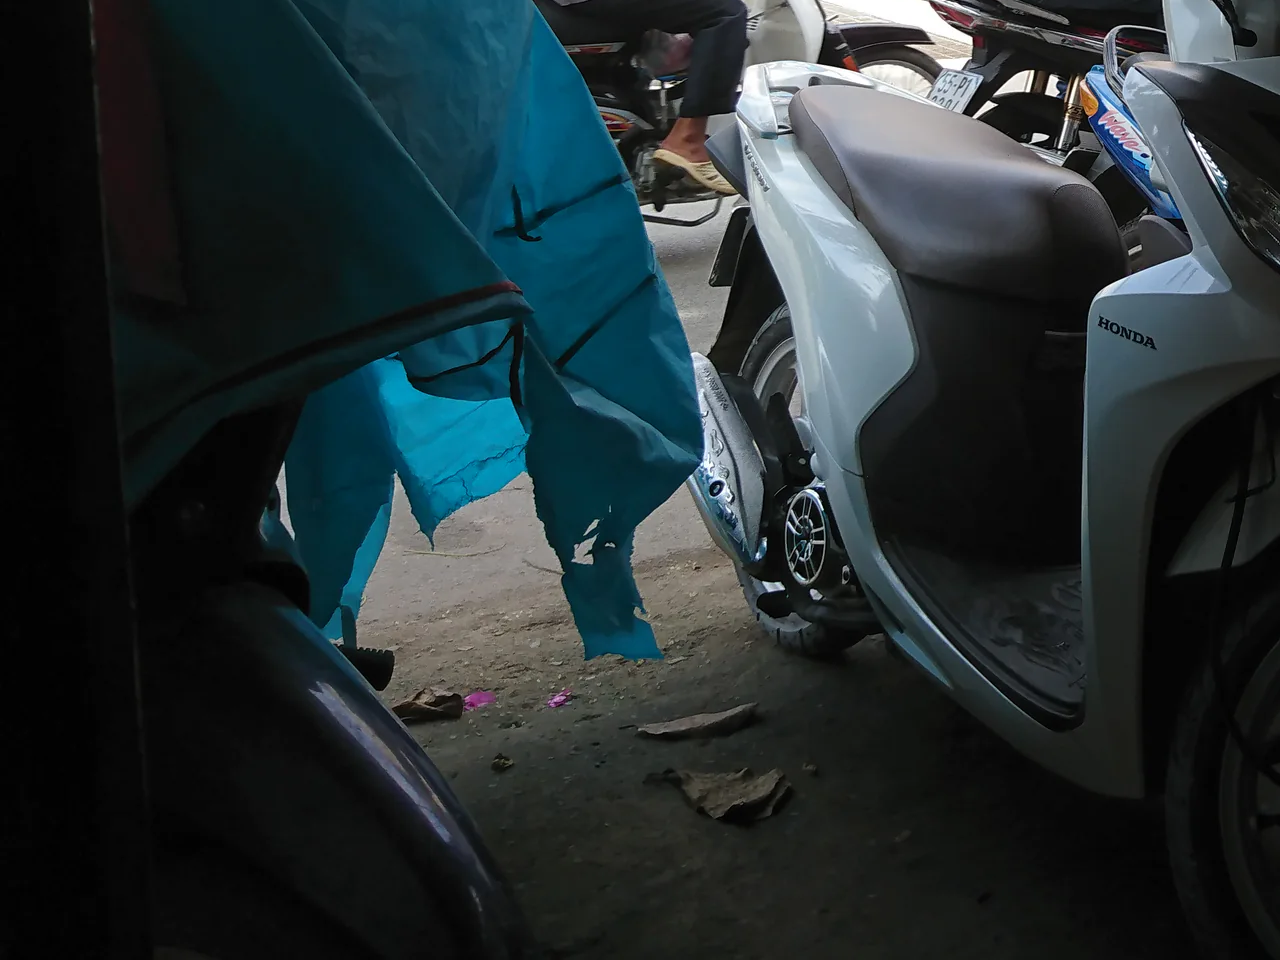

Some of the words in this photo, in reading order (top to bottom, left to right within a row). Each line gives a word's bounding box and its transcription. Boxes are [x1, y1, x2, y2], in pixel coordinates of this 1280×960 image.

[937, 73, 974, 98] 55-P1
[1098, 109, 1142, 153] Wave
[1097, 315, 1158, 351] HONDA
